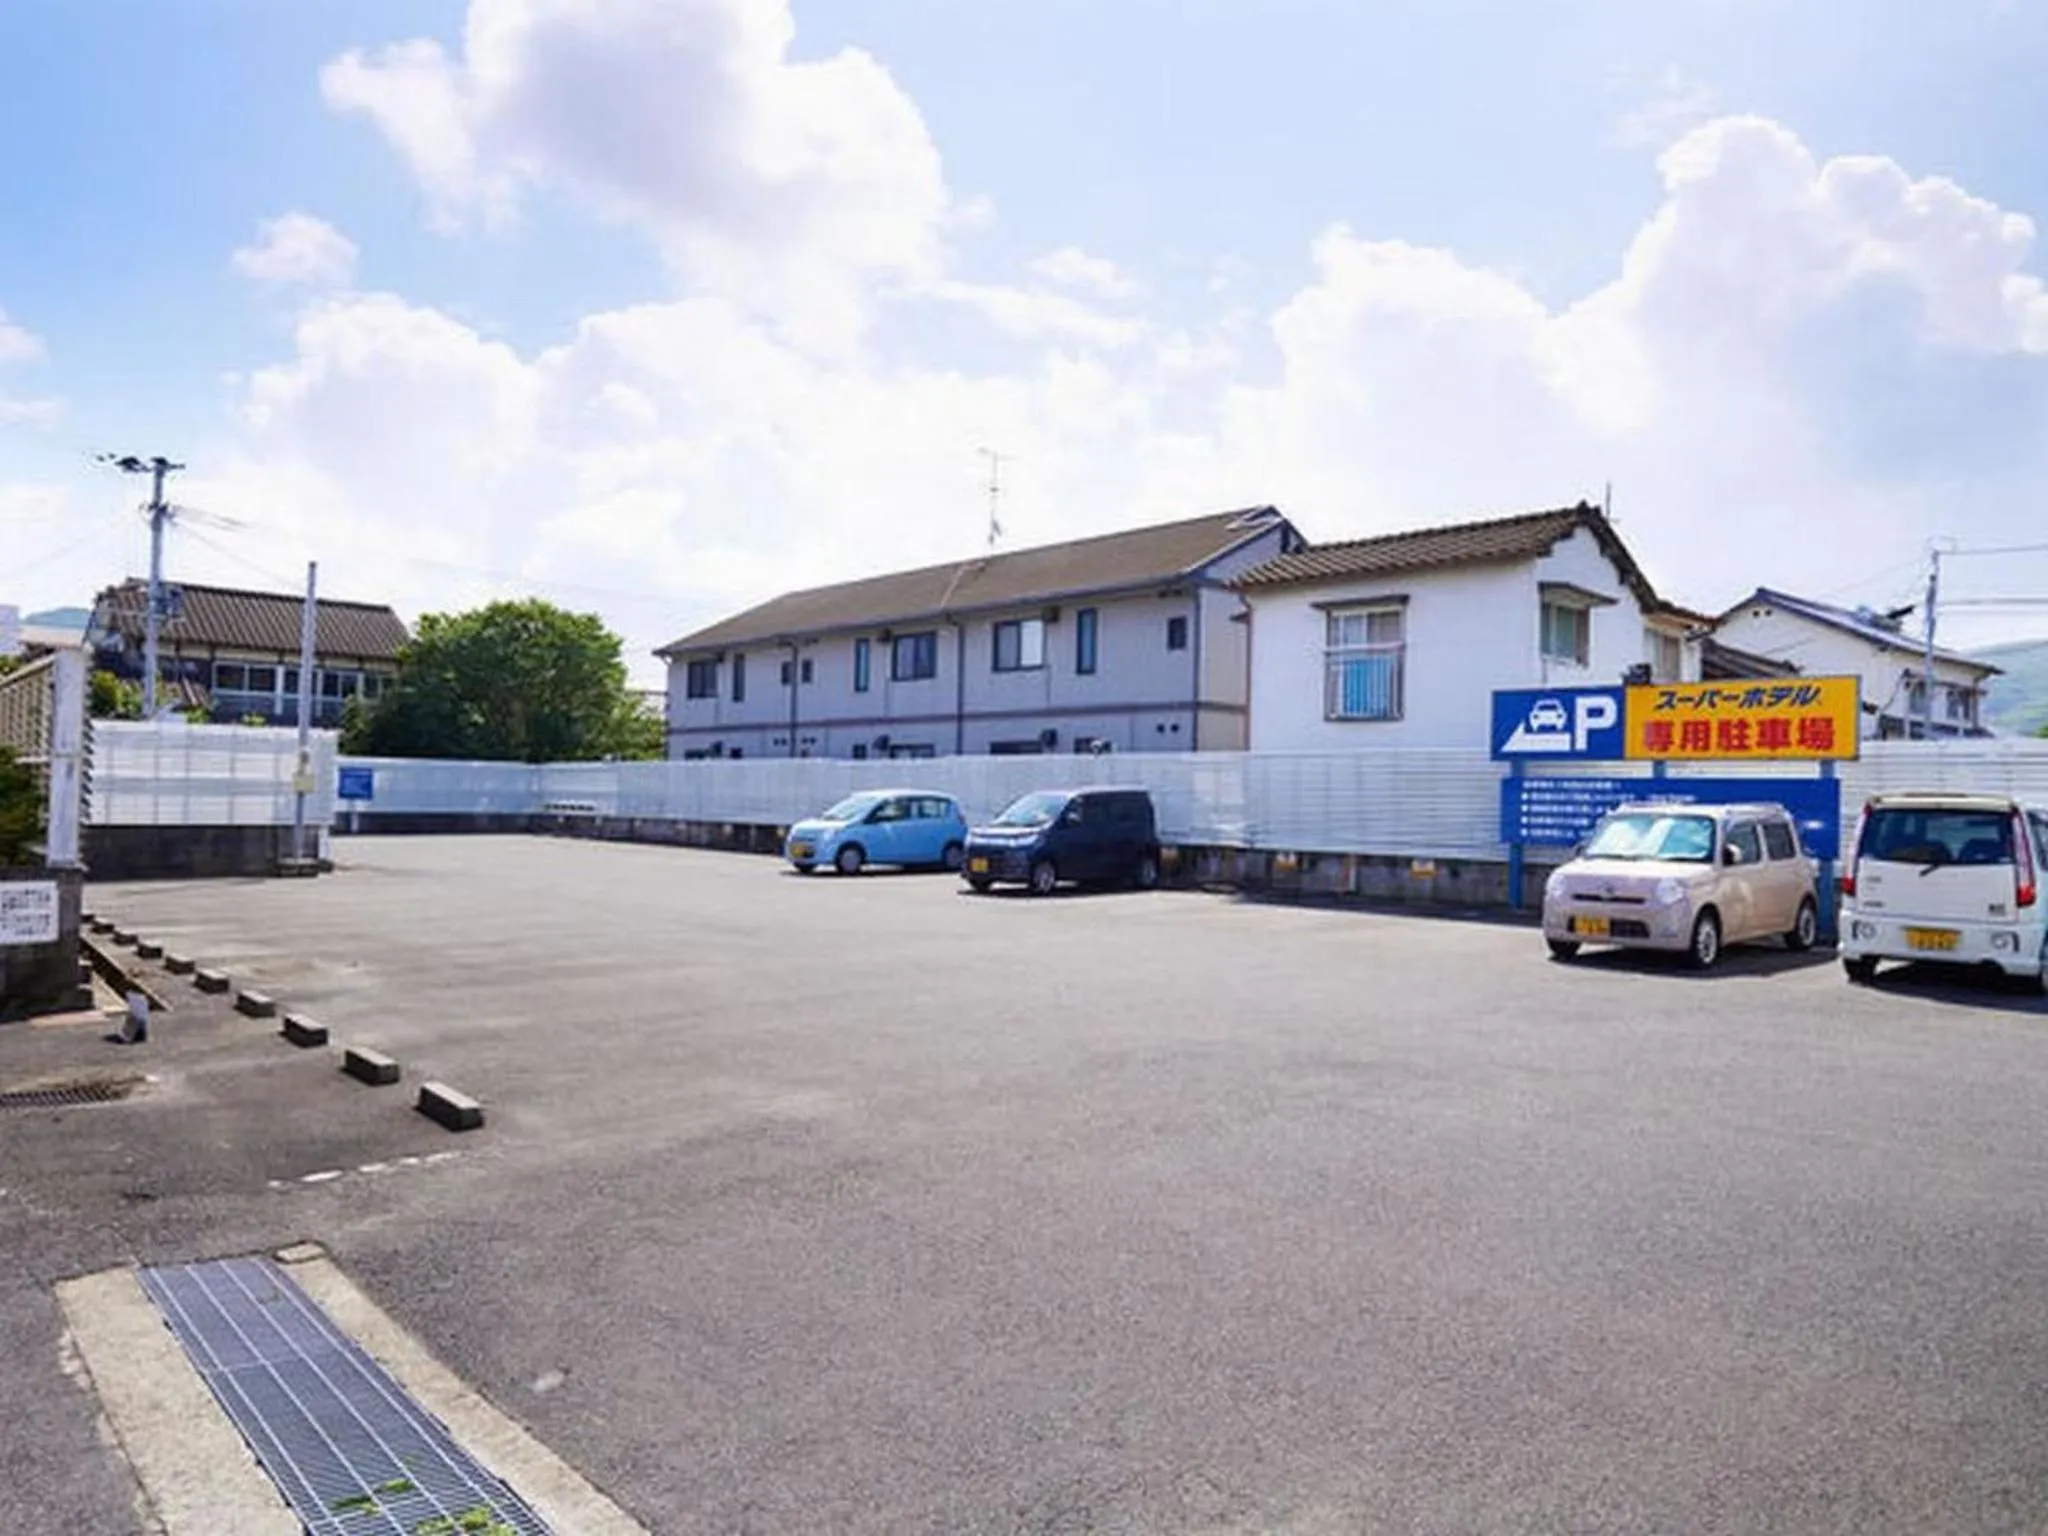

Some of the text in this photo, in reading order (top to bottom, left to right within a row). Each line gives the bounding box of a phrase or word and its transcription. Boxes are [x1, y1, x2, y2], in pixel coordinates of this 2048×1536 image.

[1653, 684, 1821, 711] スーパーホテル
[1575, 695, 1617, 750] P
[1644, 716, 1834, 752] 専用駐車場
